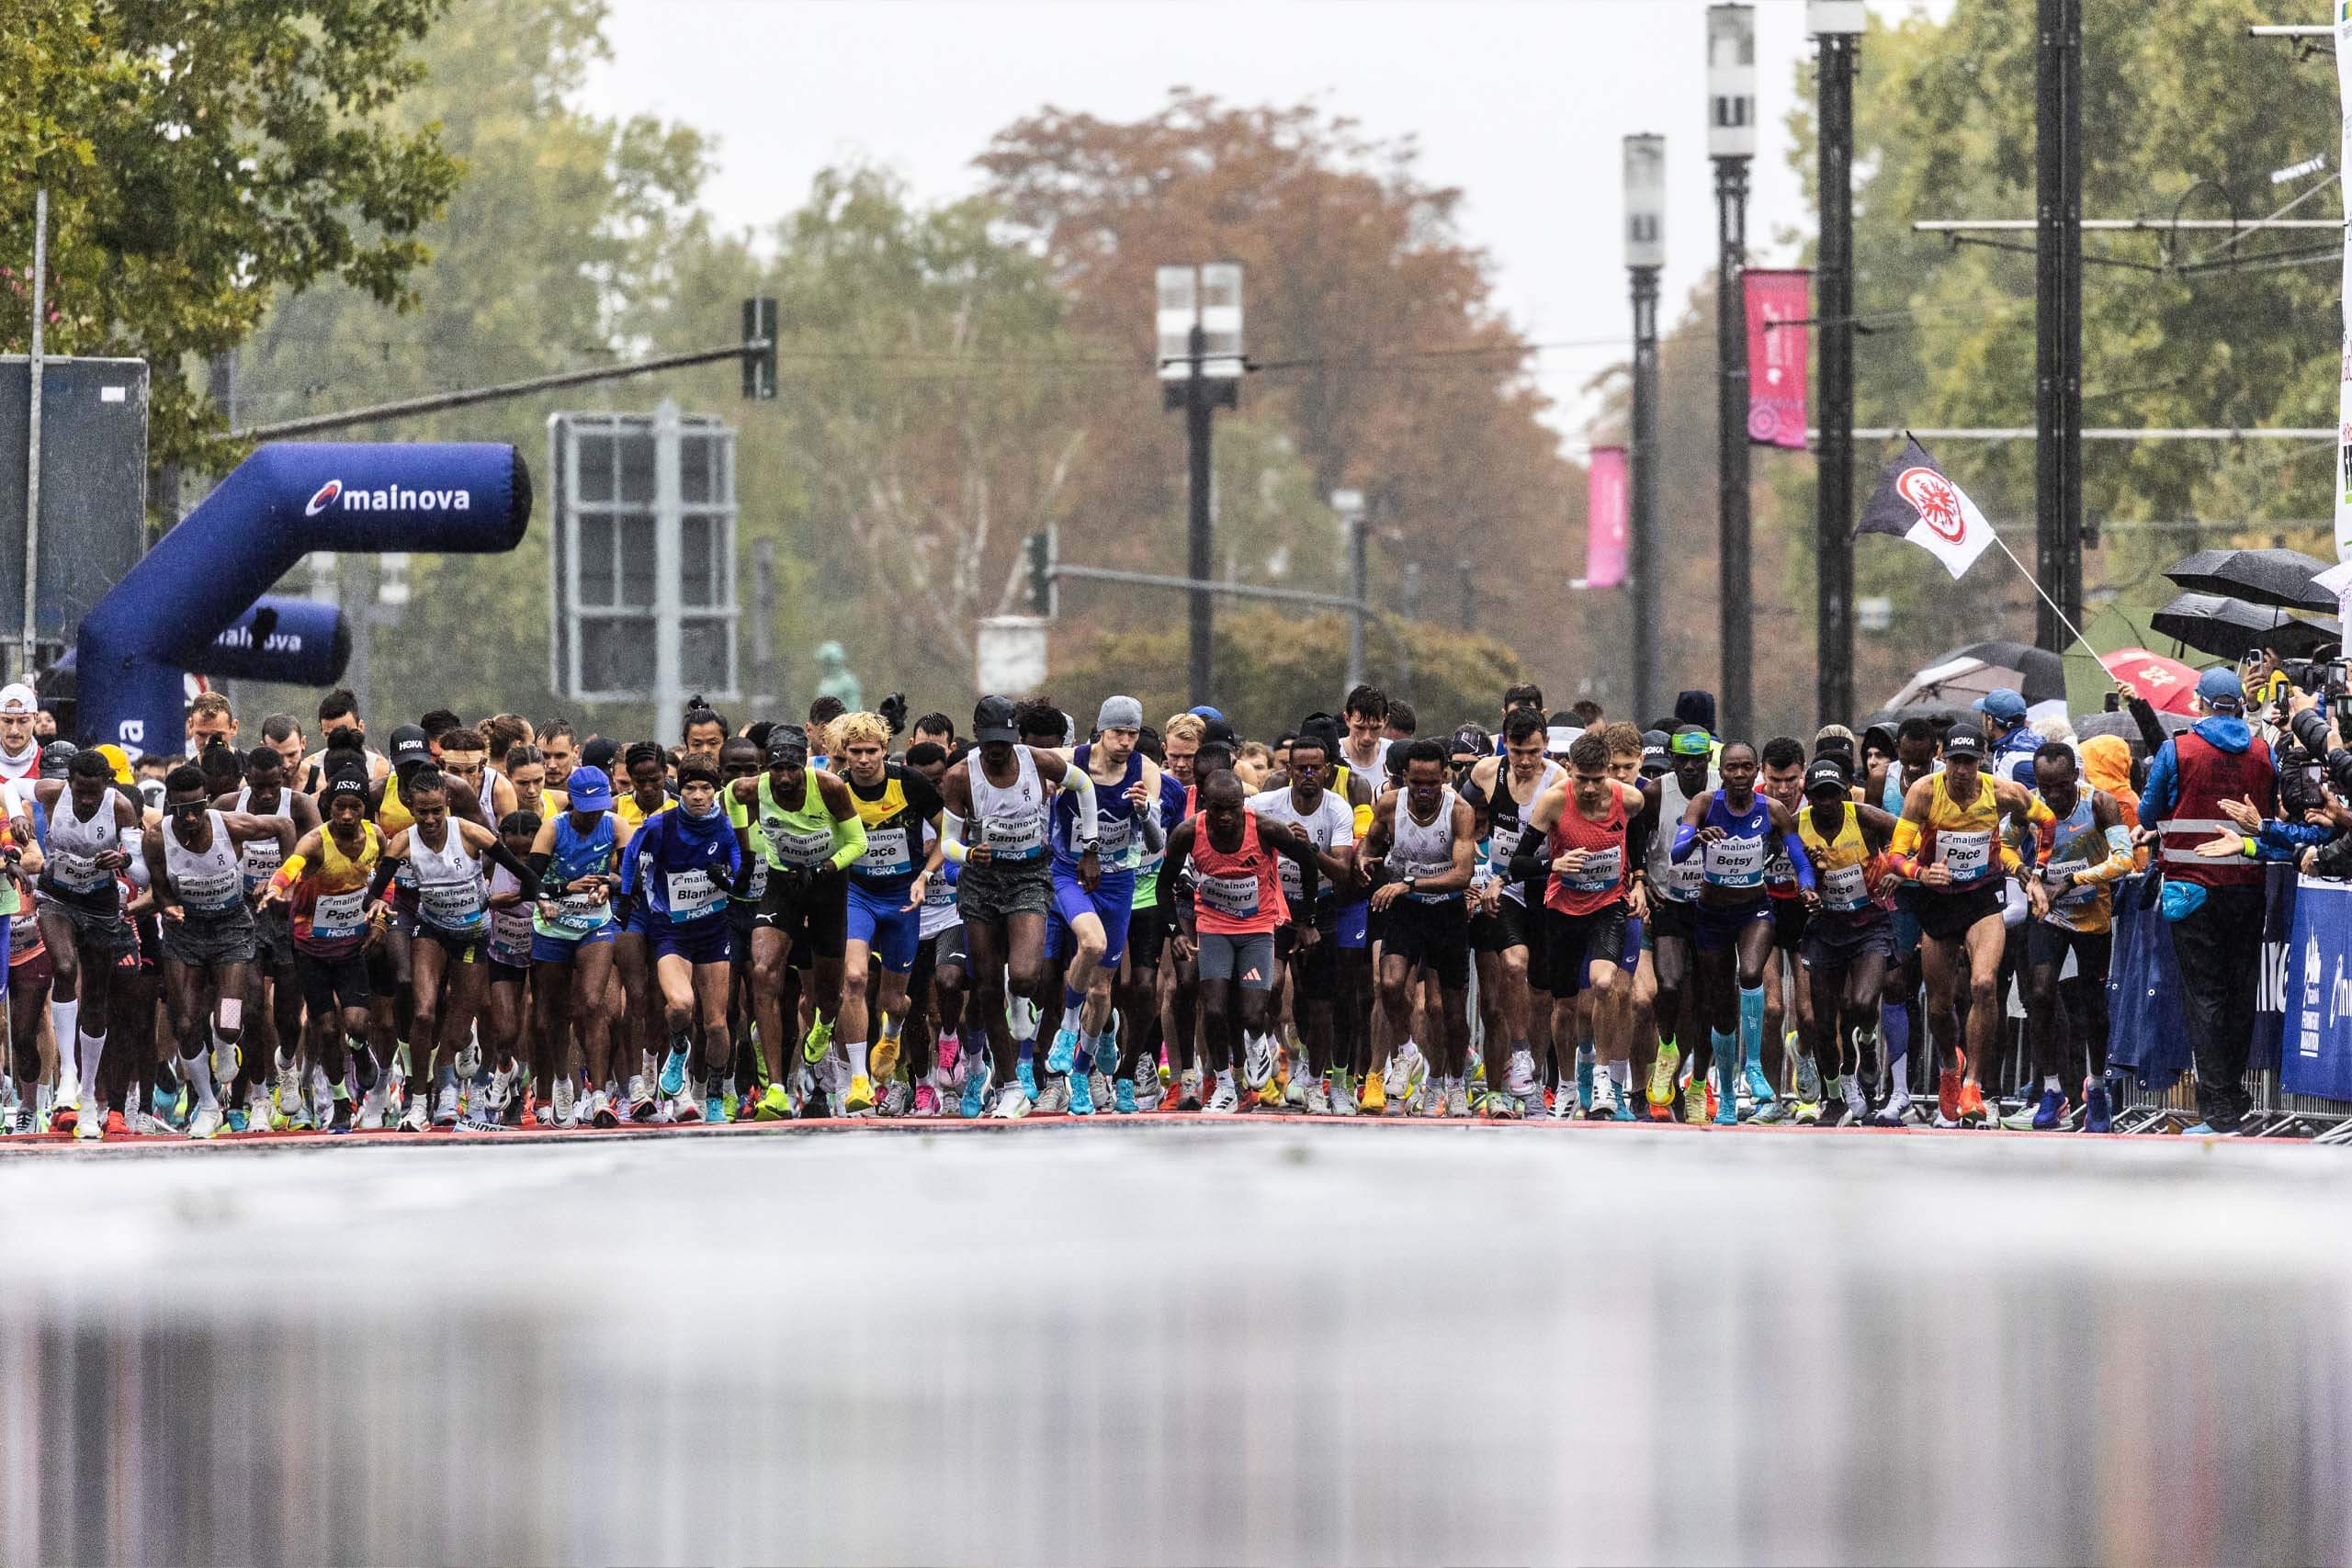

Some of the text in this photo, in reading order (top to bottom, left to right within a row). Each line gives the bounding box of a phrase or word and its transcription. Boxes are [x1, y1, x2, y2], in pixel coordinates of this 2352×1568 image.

[343, 484, 470, 511] mainova
[399, 739, 423, 750] HOKA
[1951, 737, 1975, 747] HOKA
[1815, 769, 1839, 779] HOKA
[999, 817, 1037, 830] mainova
[1099, 821, 1129, 832] ainova
[789, 830, 831, 844] mainova
[988, 829, 1035, 843] Samuel
[1952, 835, 1990, 844] mainova
[1721, 840, 1761, 851] mainova
[996, 852, 1027, 860] HOKA
[1947, 848, 1981, 861] Pace
[247, 858, 284, 870] Pace
[1716, 856, 1753, 867] Betsy
[64, 865, 100, 880] Pace
[866, 865, 897, 875] HOKA
[2049, 863, 2086, 874] mainova
[195, 872, 235, 886] mainova
[1215, 879, 1256, 889] mainova
[1719, 874, 1749, 885] HOKA
[434, 885, 476, 898] mainova
[1576, 881, 1605, 891] HOKA
[1206, 887, 1253, 902] Benard
[424, 897, 476, 908] Zeineba
[1827, 901, 1856, 911] HOKA
[325, 908, 360, 919] Pace
[685, 905, 714, 919] HOKA
[1215, 904, 1244, 918] HOKA
[559, 917, 589, 929] HOKA
[326, 928, 356, 937] HOKA
